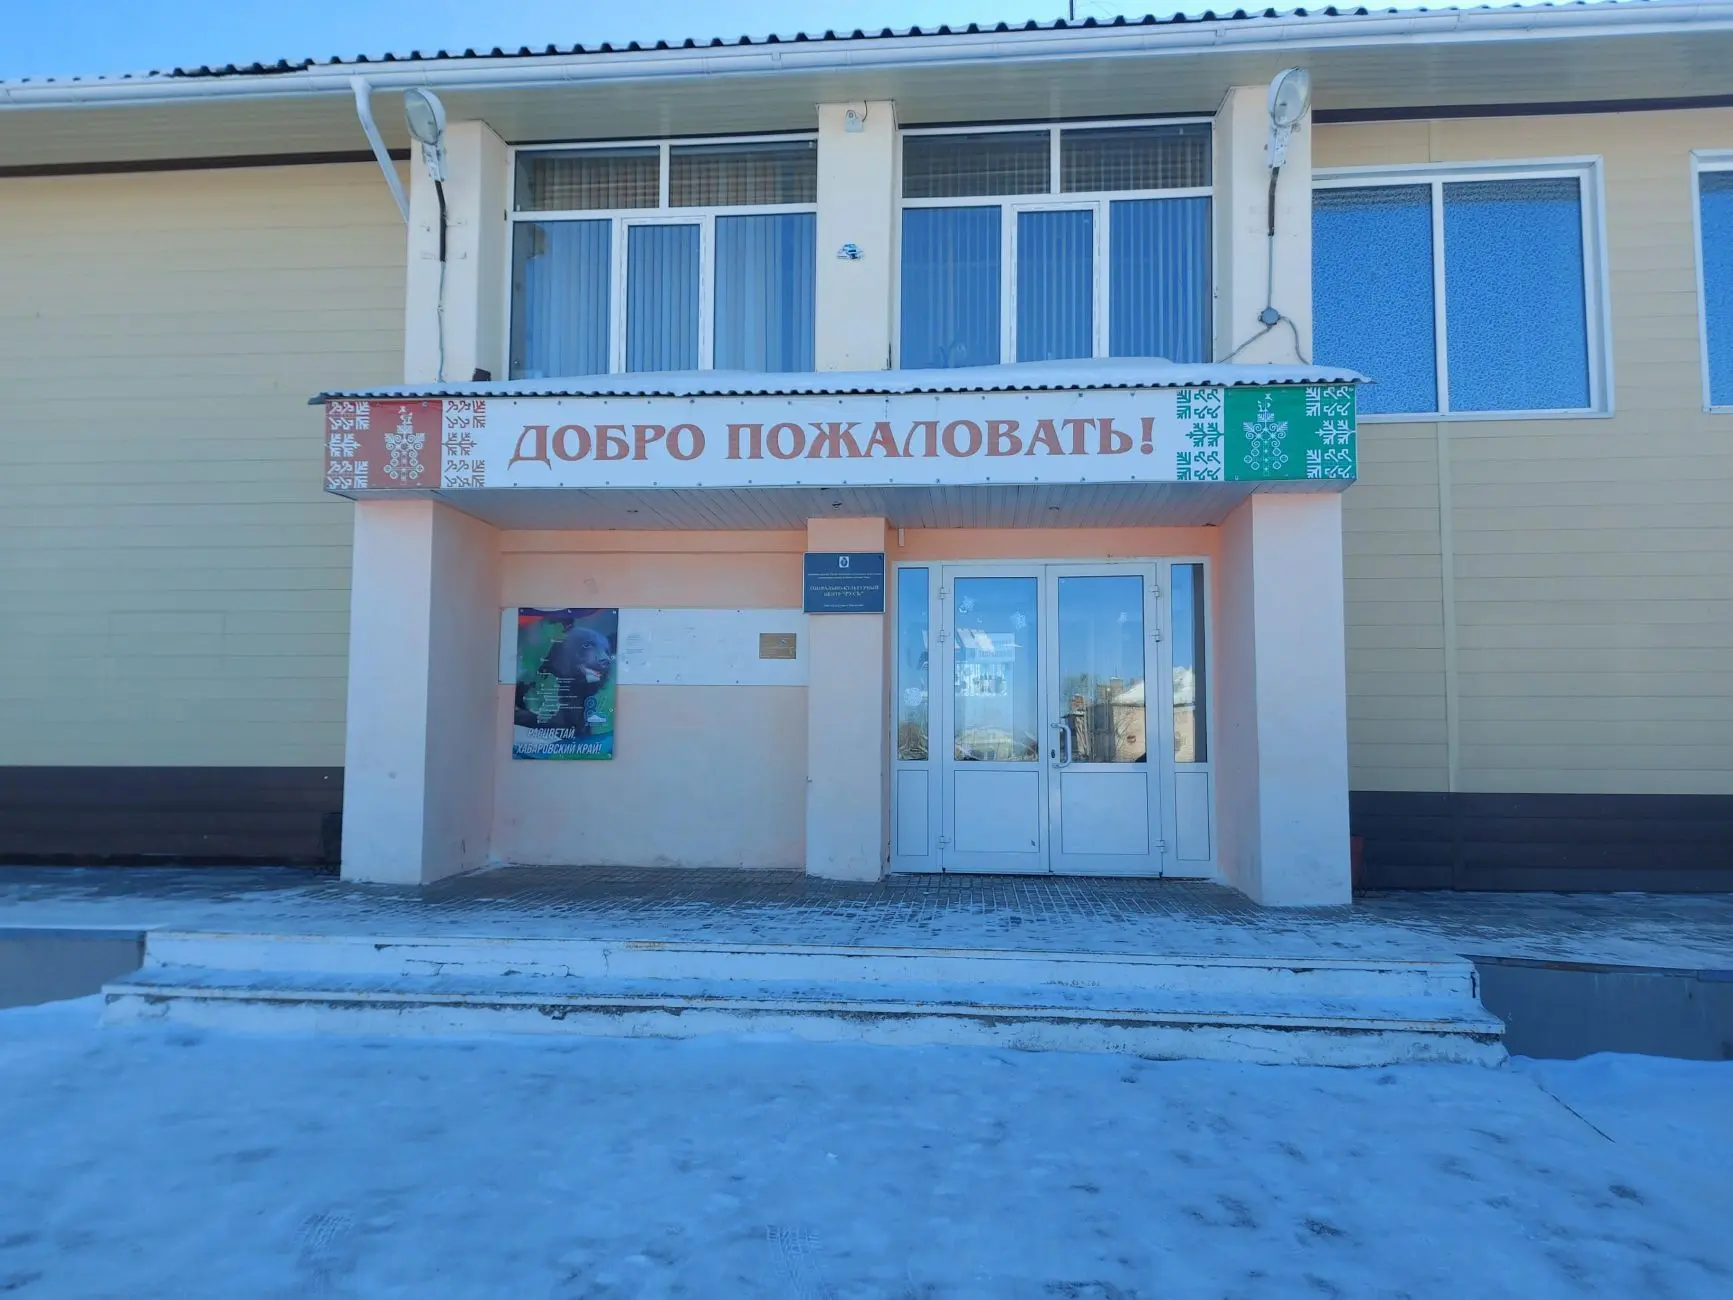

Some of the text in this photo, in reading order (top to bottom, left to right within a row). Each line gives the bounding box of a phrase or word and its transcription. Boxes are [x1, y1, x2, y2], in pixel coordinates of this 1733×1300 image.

[507, 417, 1156, 471] ДОБРО ПОЖАЛОВАТЬ!
[516, 742, 602, 754] ХАБАРОВСКИЙ КРАЙ!
